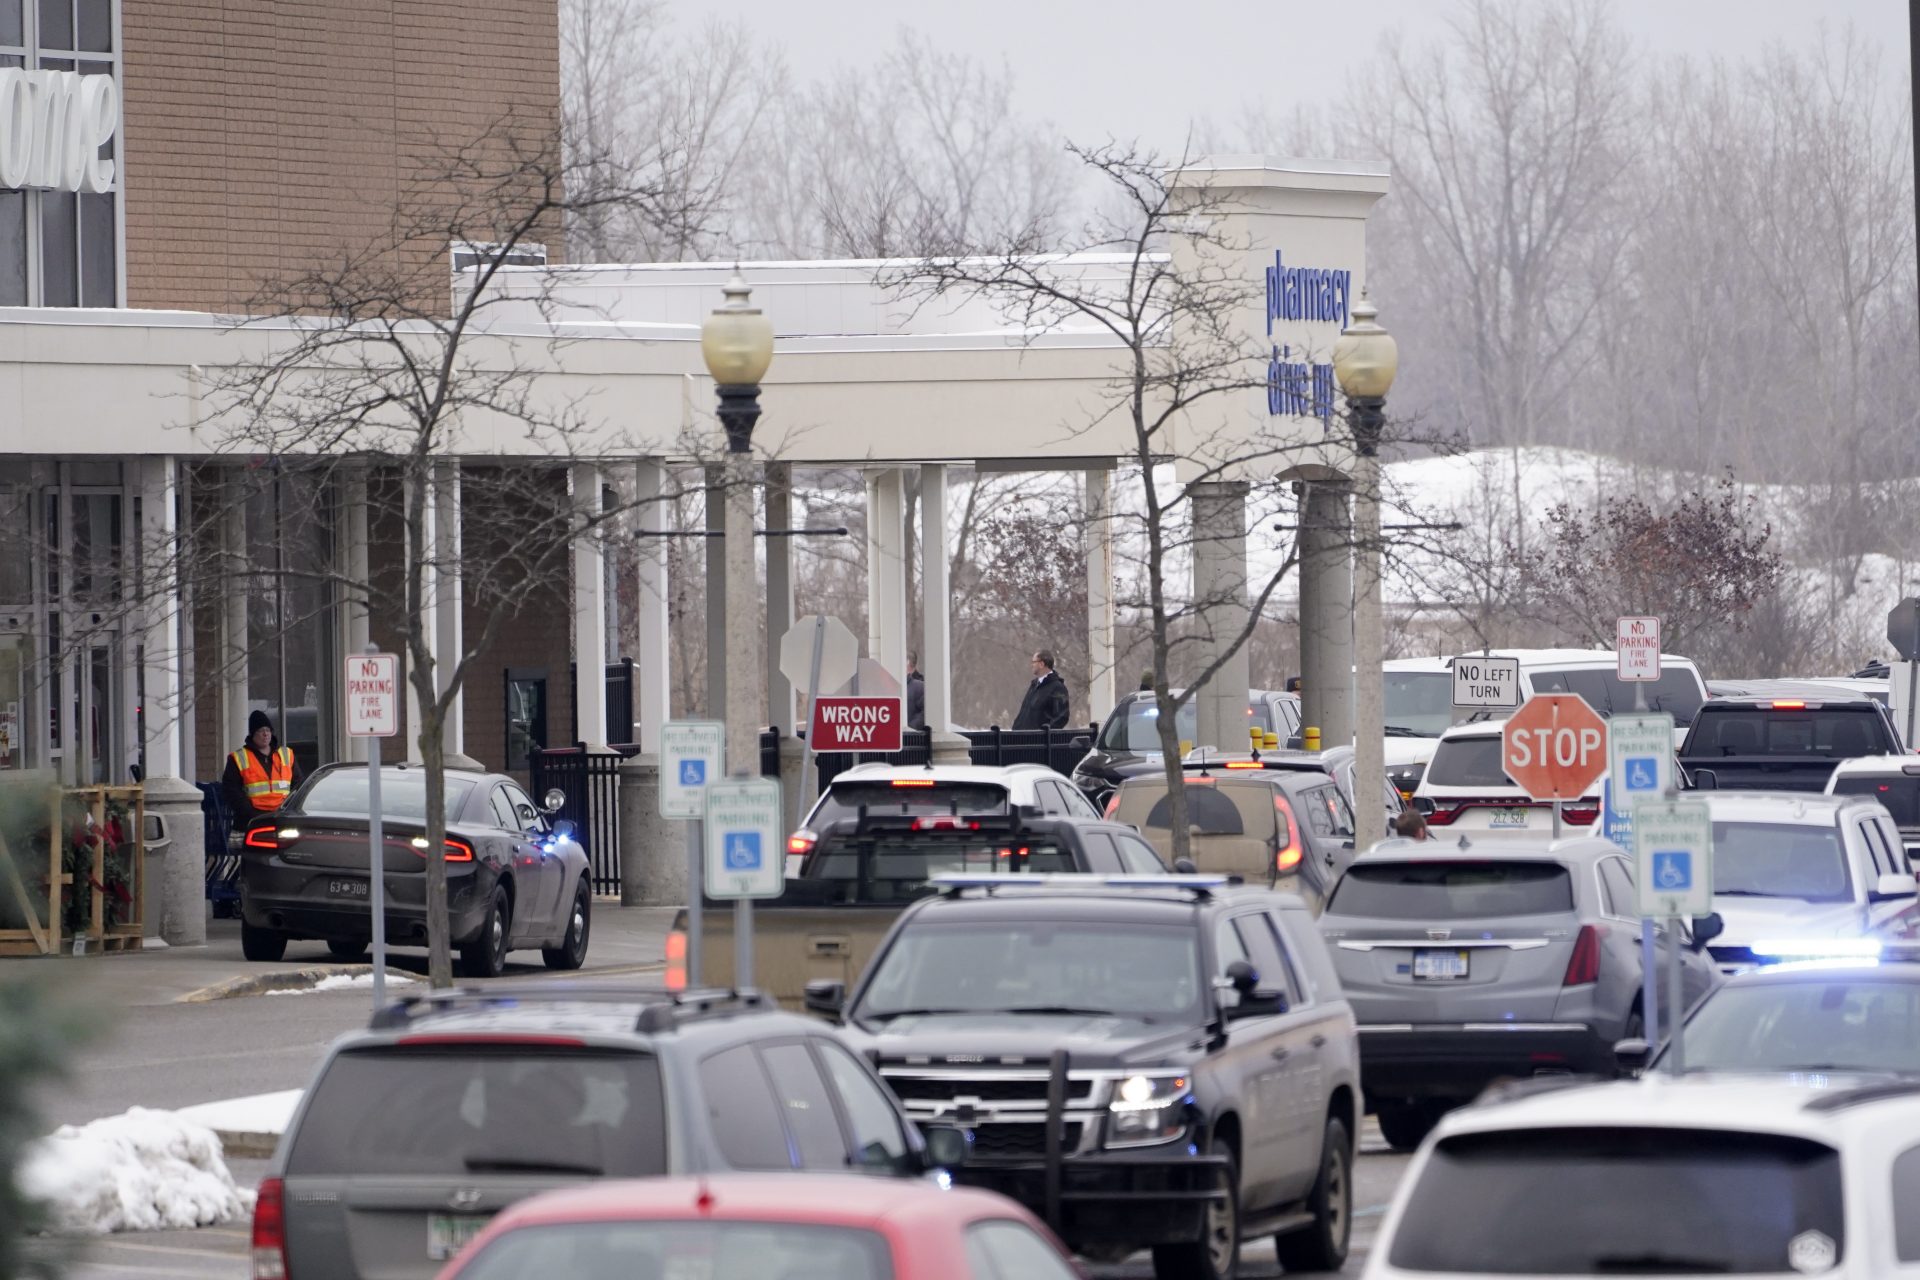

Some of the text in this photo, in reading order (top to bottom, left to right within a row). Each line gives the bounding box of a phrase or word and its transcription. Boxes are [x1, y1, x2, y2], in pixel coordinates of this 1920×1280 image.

[1266, 249, 1351, 336] pharmacy
[1268, 345, 1334, 433] drive up
[1631, 623, 1646, 635] NO
[1621, 636, 1657, 649] PARKING
[1630, 650, 1647, 658] FIRE
[362, 662, 379, 677] NO
[1629, 660, 1649, 668] LANE
[1460, 665, 1513, 681] NO LEFT
[350, 680, 392, 695] PARKING
[1469, 685, 1501, 698] TURN
[361, 697, 381, 707] FIRE
[360, 709, 383, 720] LANE
[822, 705, 892, 724] WRONG
[835, 725, 877, 743] WAY
[671, 745, 712, 754] PARKING
[1509, 727, 1602, 768] STOP
[1618, 742, 1665, 752] PARKING
[717, 813, 770, 824] PARKING
[1644, 832, 1699, 844] PARKING
